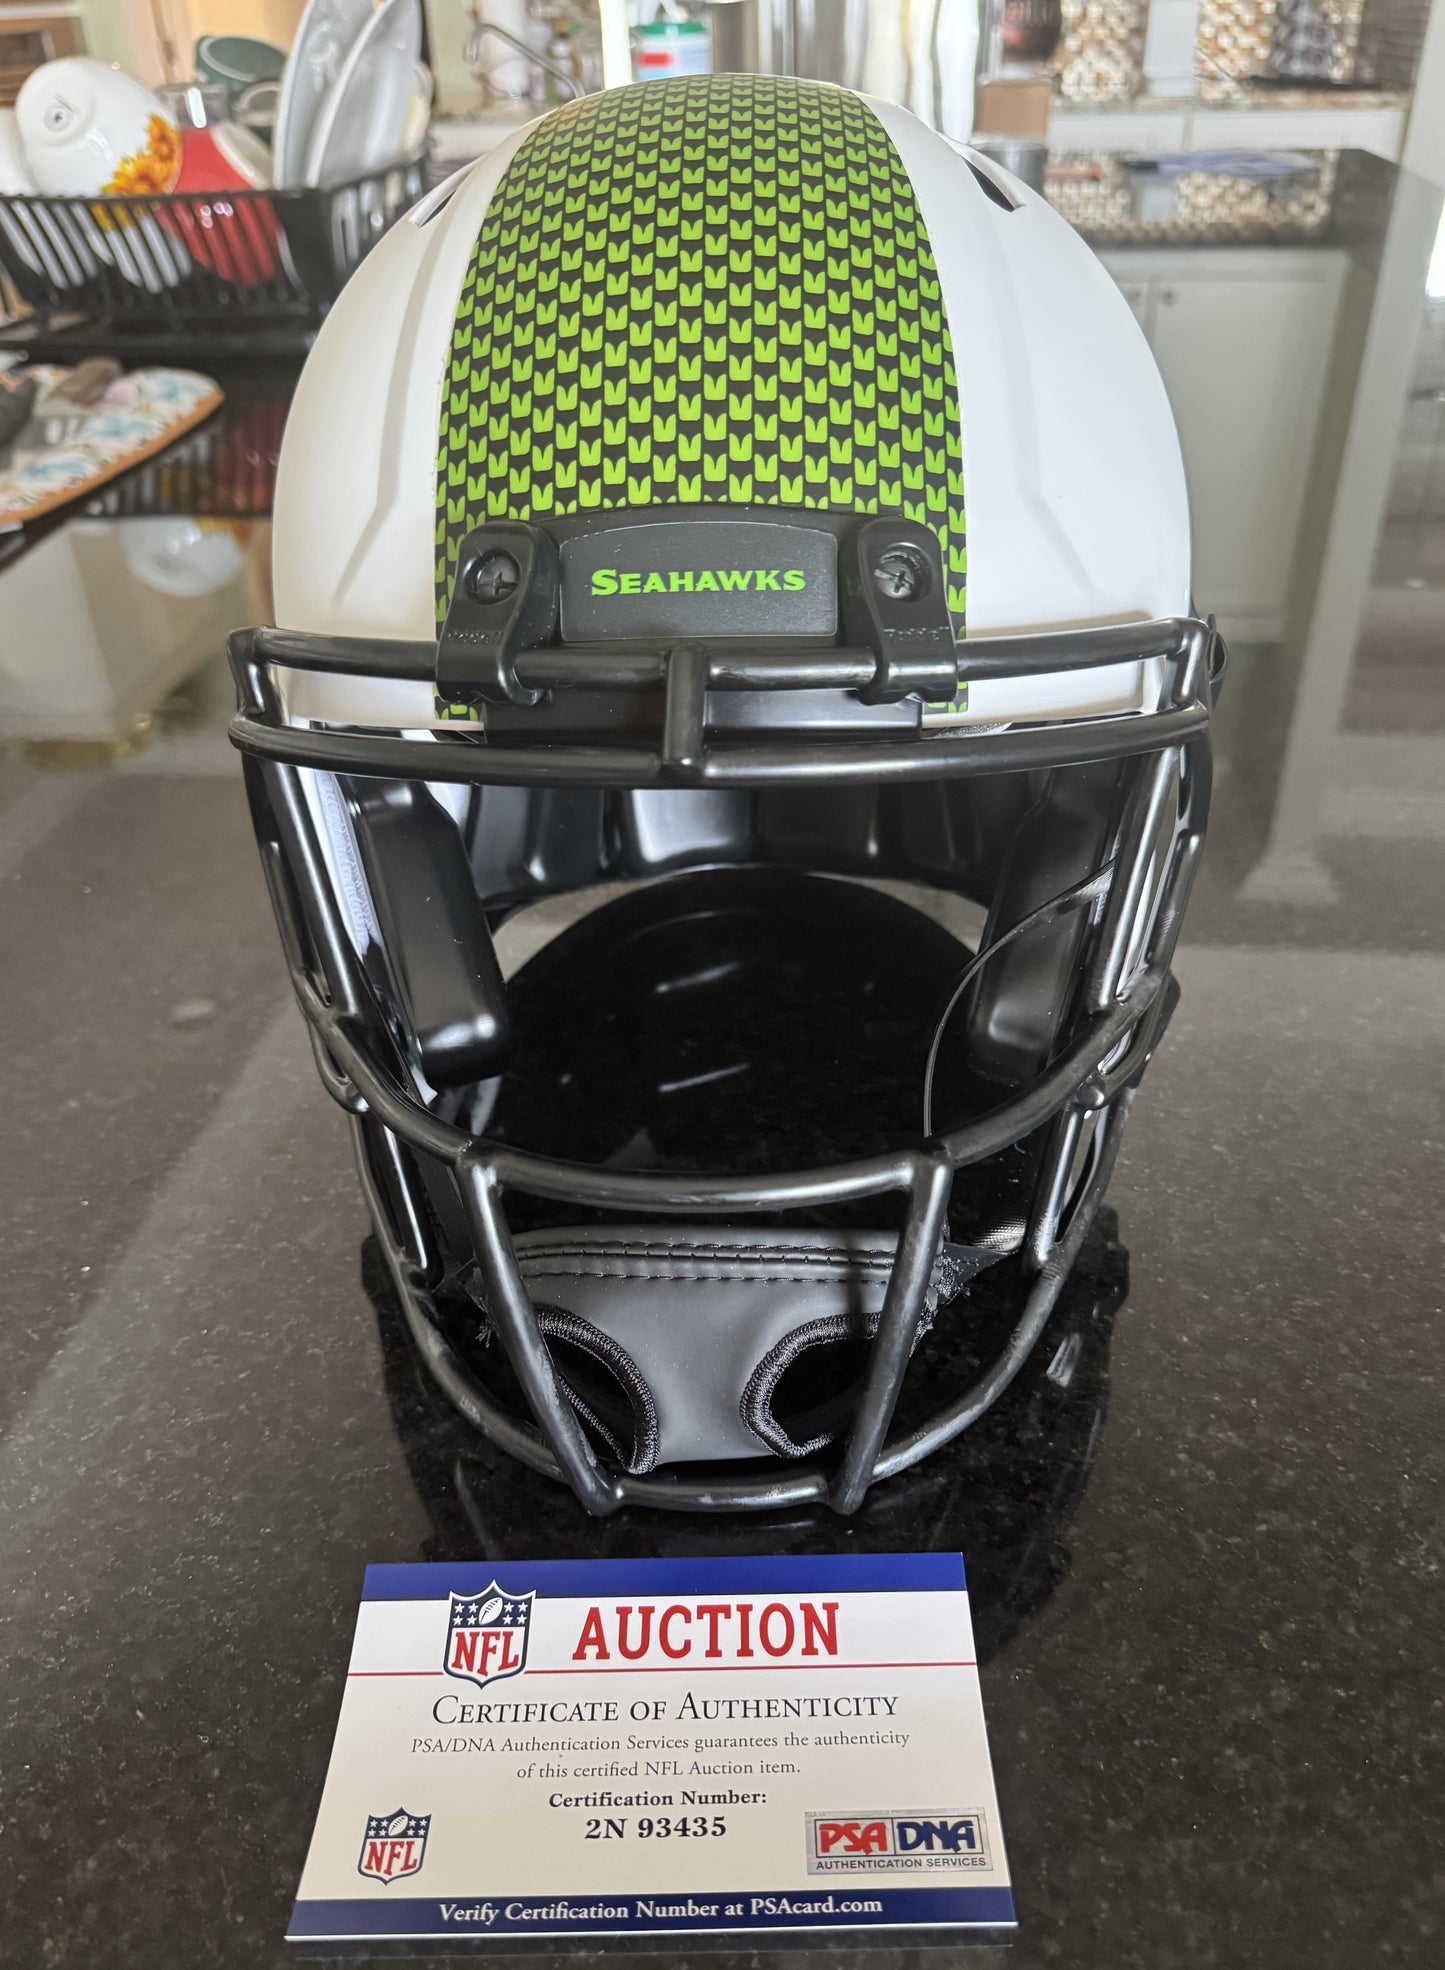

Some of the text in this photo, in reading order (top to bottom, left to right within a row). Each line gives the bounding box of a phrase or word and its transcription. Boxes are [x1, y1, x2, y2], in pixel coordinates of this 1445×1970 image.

[591, 568, 805, 595] SEAHAWKS
[572, 1602, 839, 1660] AUCTION
[451, 1631, 519, 1677] NFL
[432, 1691, 898, 1724] CERTIFICATE OF AUTHENTICITY
[411, 1731, 910, 1753] PSA/DNA Authentication Services guarantees the authenticity
[516, 1760, 801, 1779] of this certified NFL Auction item.
[549, 1790, 767, 1808] Certification Number:
[585, 1815, 727, 1840] 2N 93435
[818, 1821, 888, 1856] PSA
[896, 1820, 977, 1853] DNA
[364, 1840, 418, 1876] NFL
[815, 1856, 987, 1870] AUTHENTICATION SERVICES
[438, 1895, 884, 1925] Verify Certification Number at PSAcard.com
